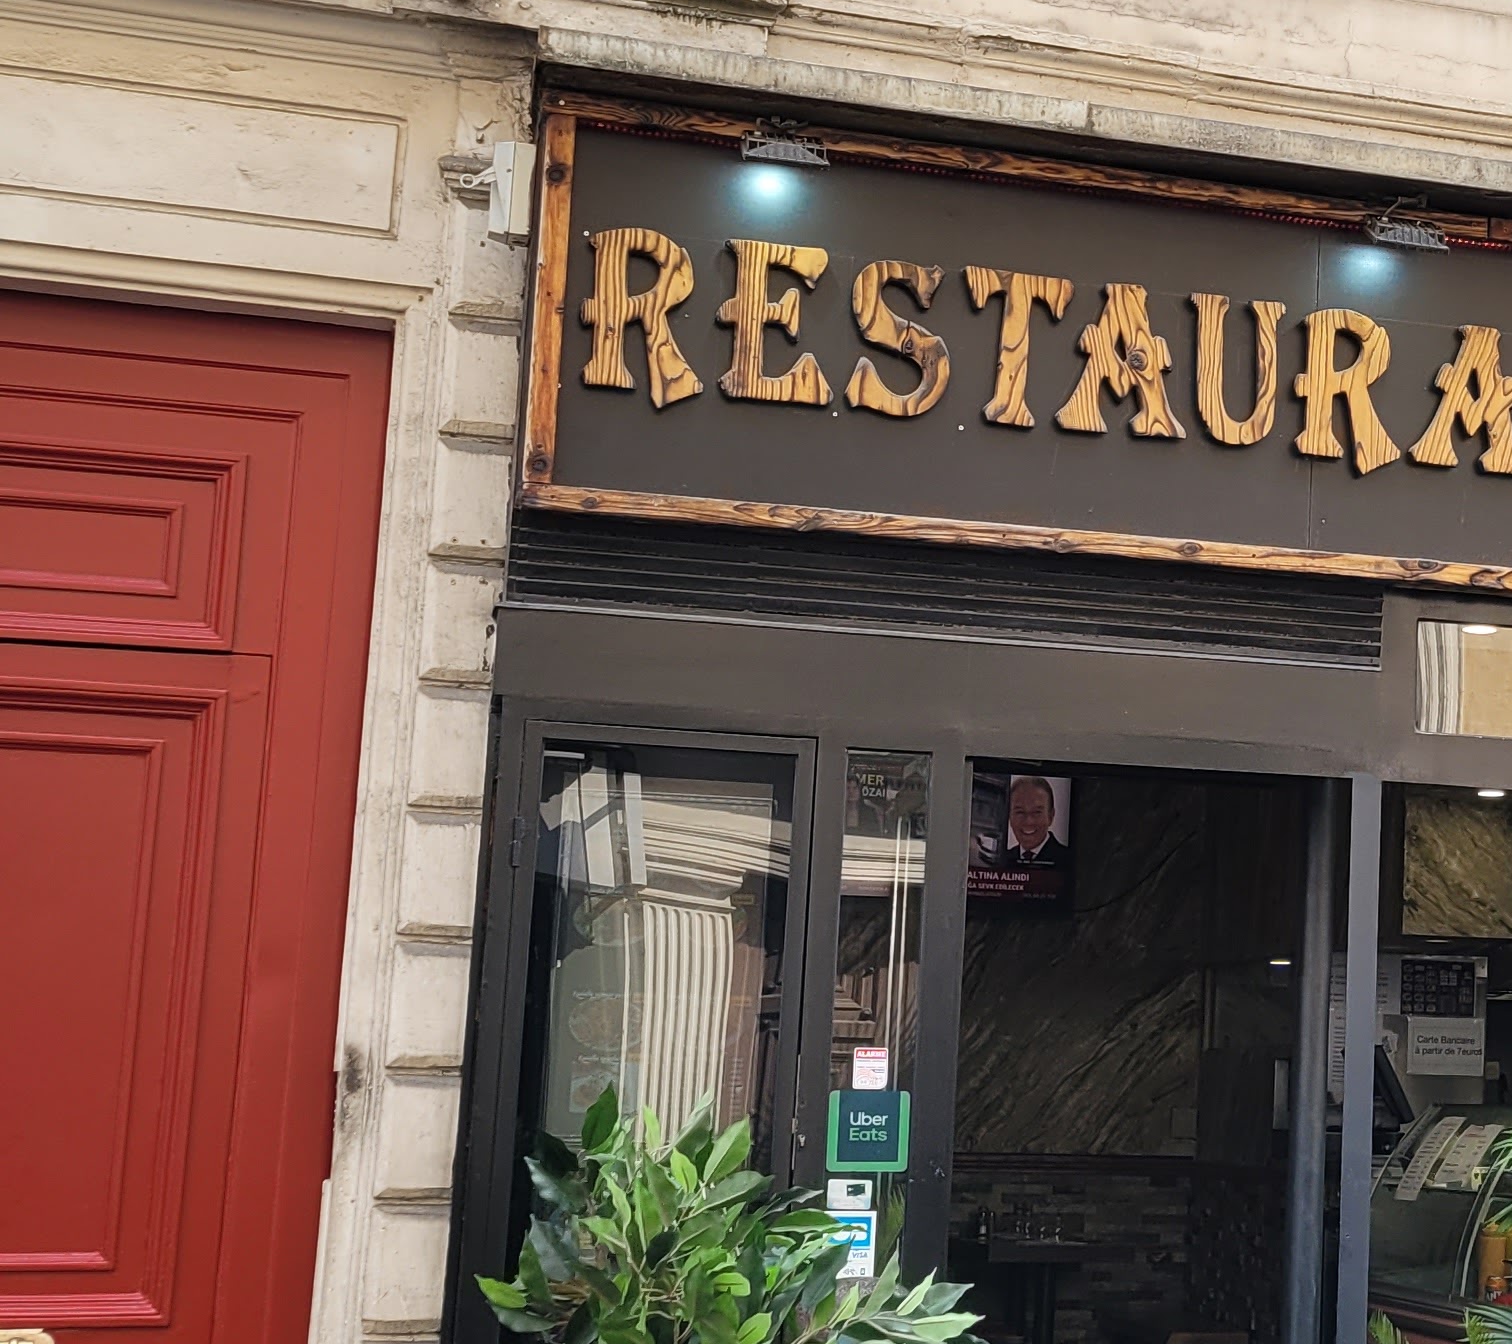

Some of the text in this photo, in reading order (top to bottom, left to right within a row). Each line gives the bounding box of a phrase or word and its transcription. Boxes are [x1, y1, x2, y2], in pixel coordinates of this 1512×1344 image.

[1417, 1035, 1475, 1045] Carte Bancaire
[1422, 1047, 1443, 1056] partir
[1445, 1047, 1455, 1055] de
[850, 1111, 889, 1126] Uber
[849, 1127, 888, 1141] Eats
